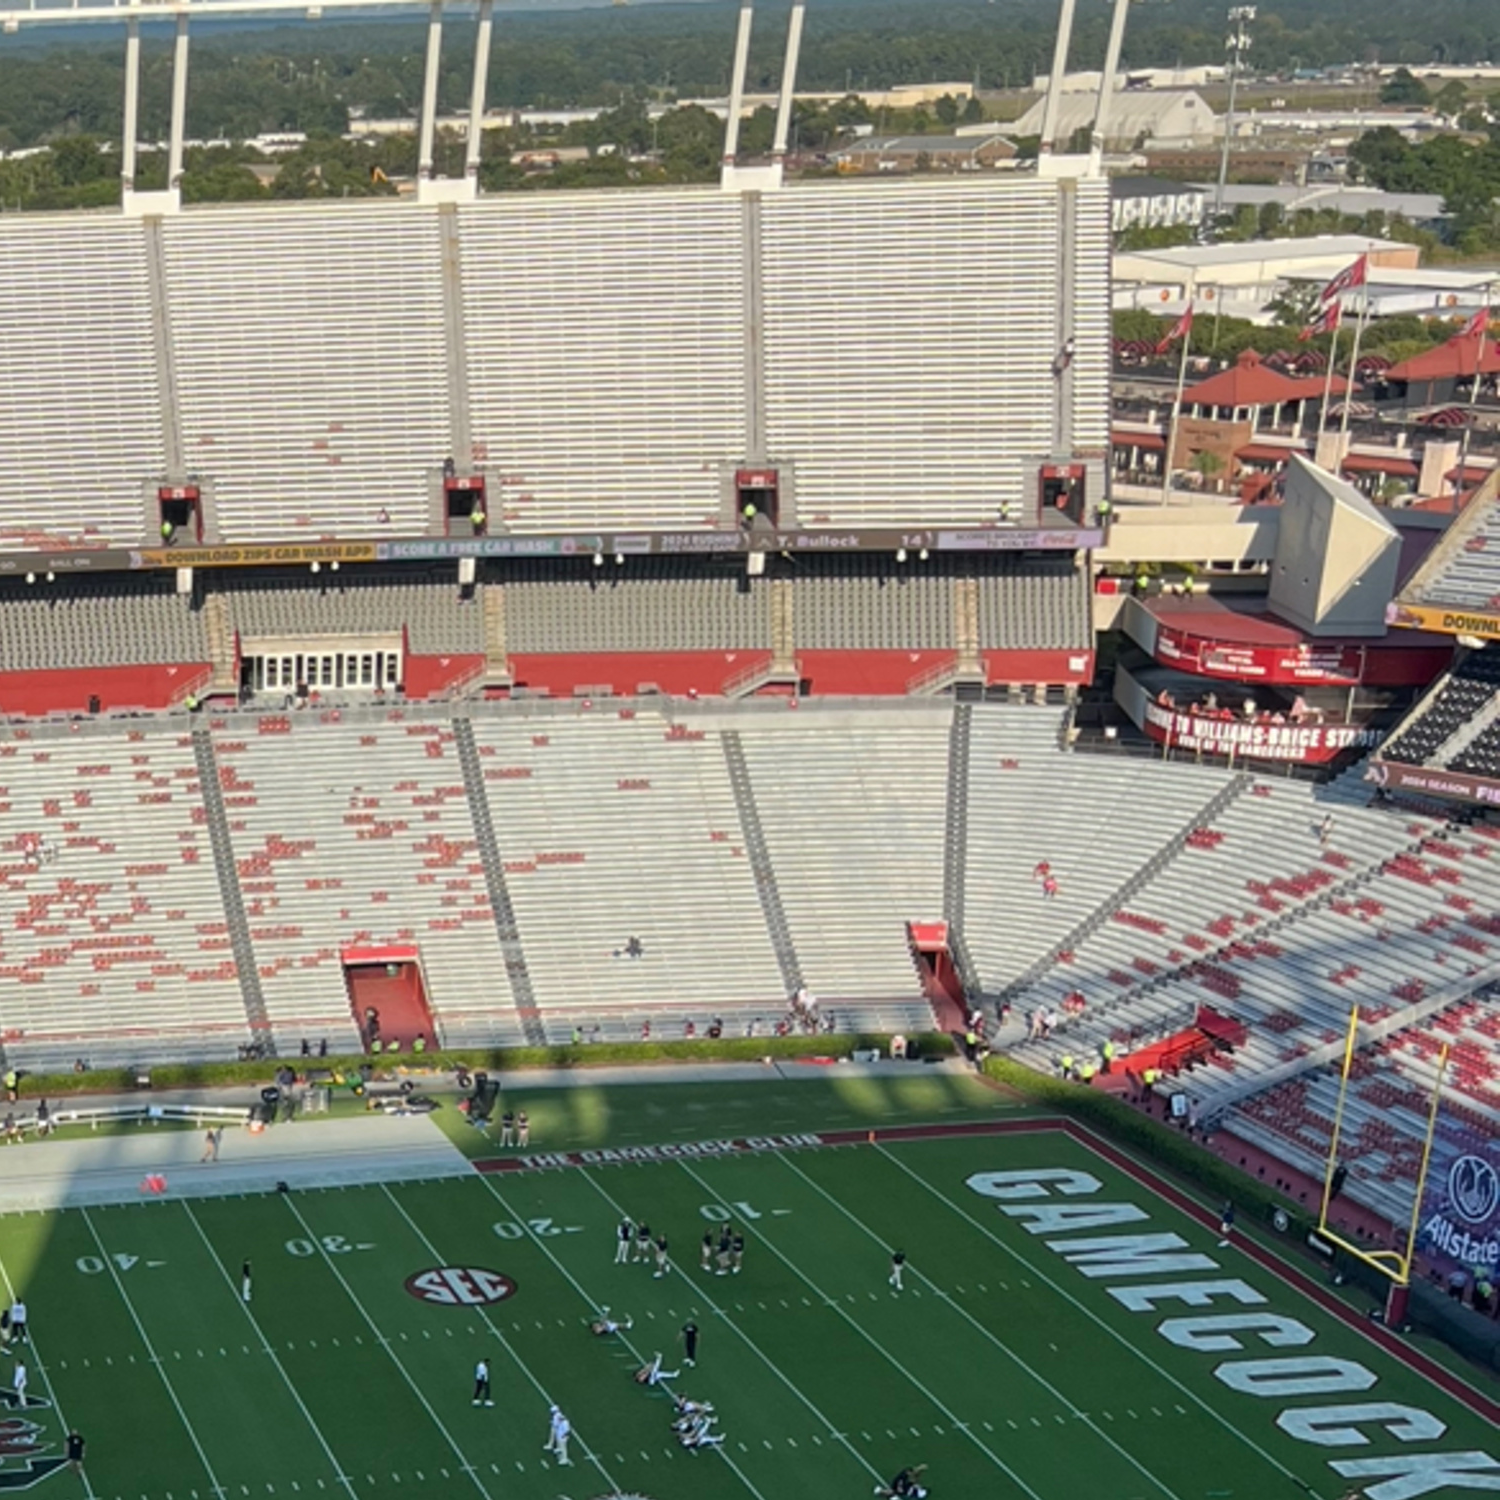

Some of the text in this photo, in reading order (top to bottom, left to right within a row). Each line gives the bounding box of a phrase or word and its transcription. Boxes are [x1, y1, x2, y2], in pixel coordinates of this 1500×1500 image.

[393, 541, 555, 557] SCORE A FREE CAR WASH
[777, 536, 859, 548] T. Bullock
[902, 534, 922, 547] 14
[165, 545, 373, 564] DOWNLOAD ZIPS CAR WASH APP
[1443, 615, 1500, 633] DOWNL
[519, 1132, 822, 1170] THE GAMECOCK CLUB
[1425, 1214, 1499, 1263] Allstate
[411, 1268, 510, 1303] SEC
